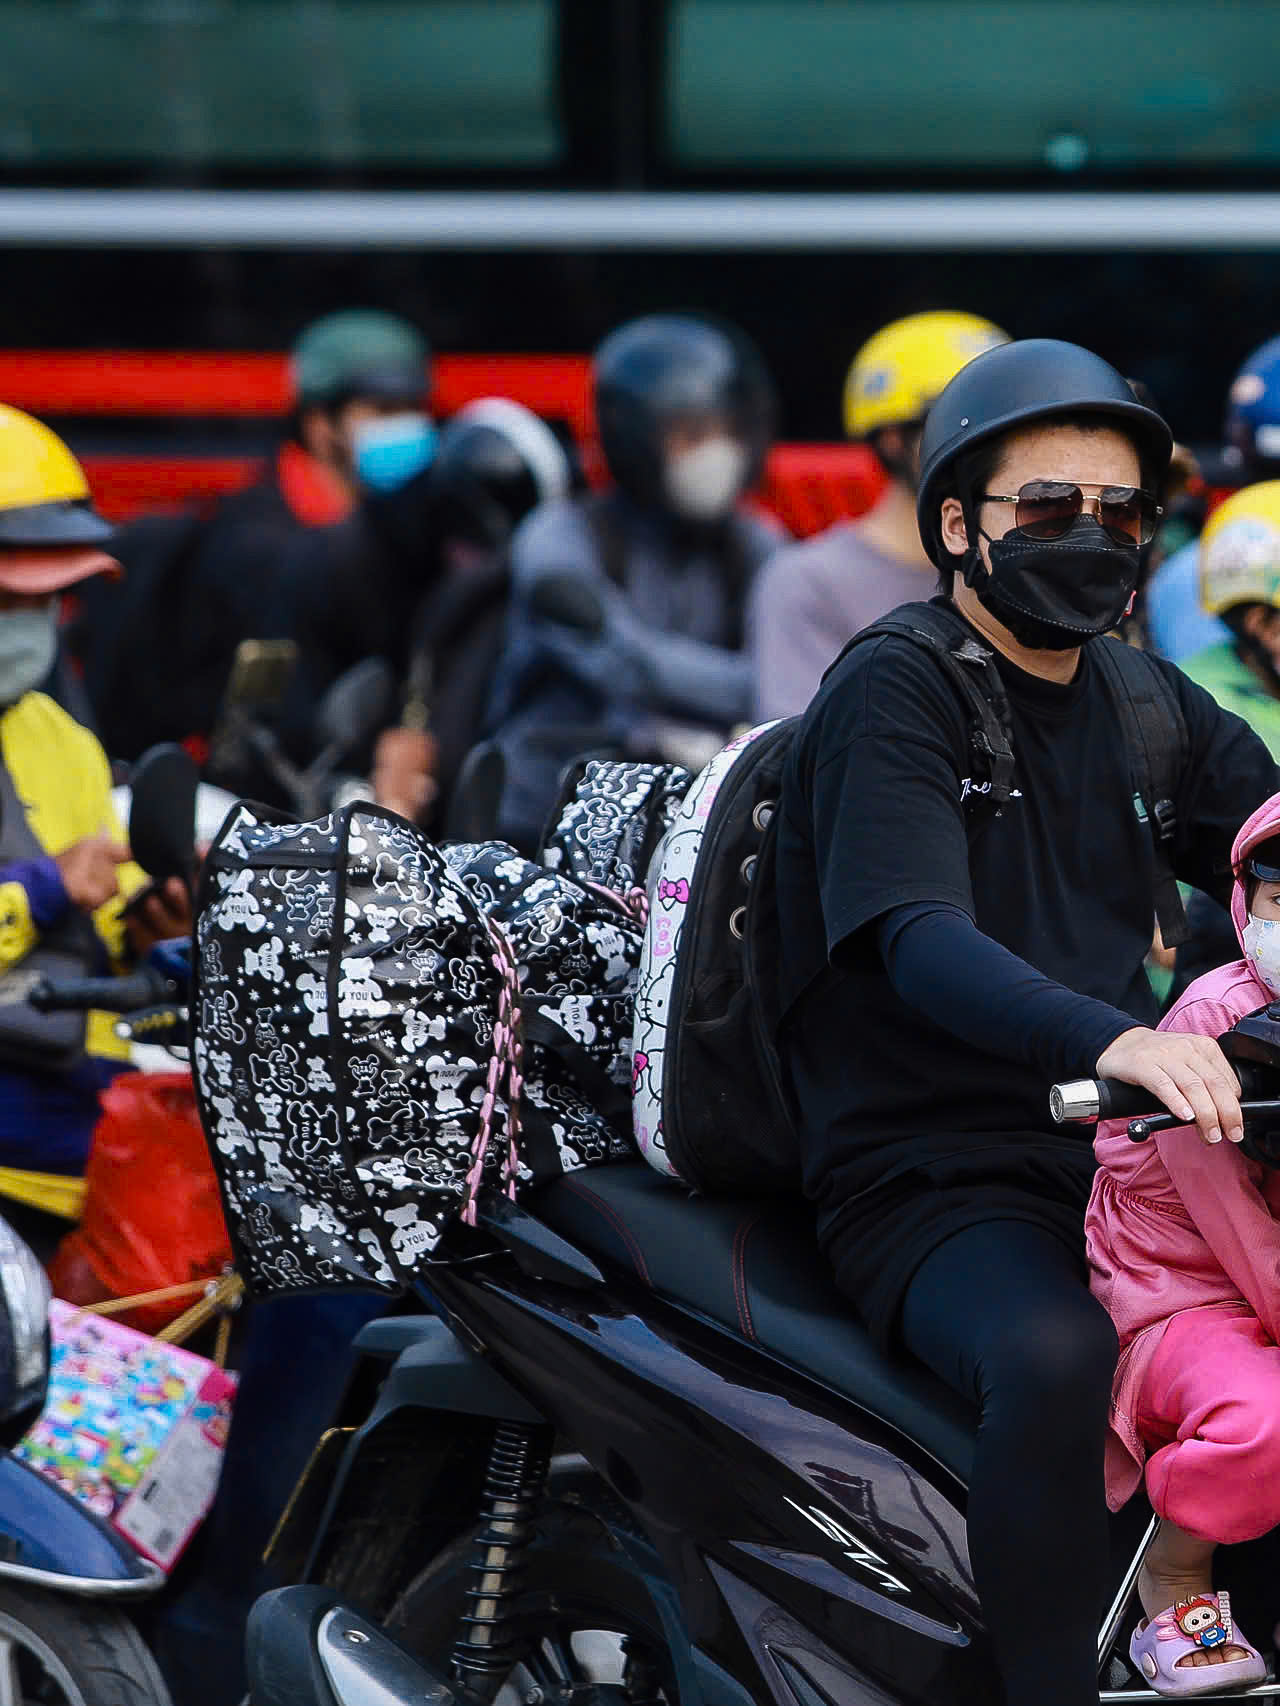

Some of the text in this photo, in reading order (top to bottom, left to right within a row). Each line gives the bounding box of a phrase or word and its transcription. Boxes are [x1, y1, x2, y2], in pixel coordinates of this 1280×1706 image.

[572, 1007, 580, 1026] YOU
[302, 1120, 310, 1138] YOU
[407, 1233, 425, 1247] YOU
